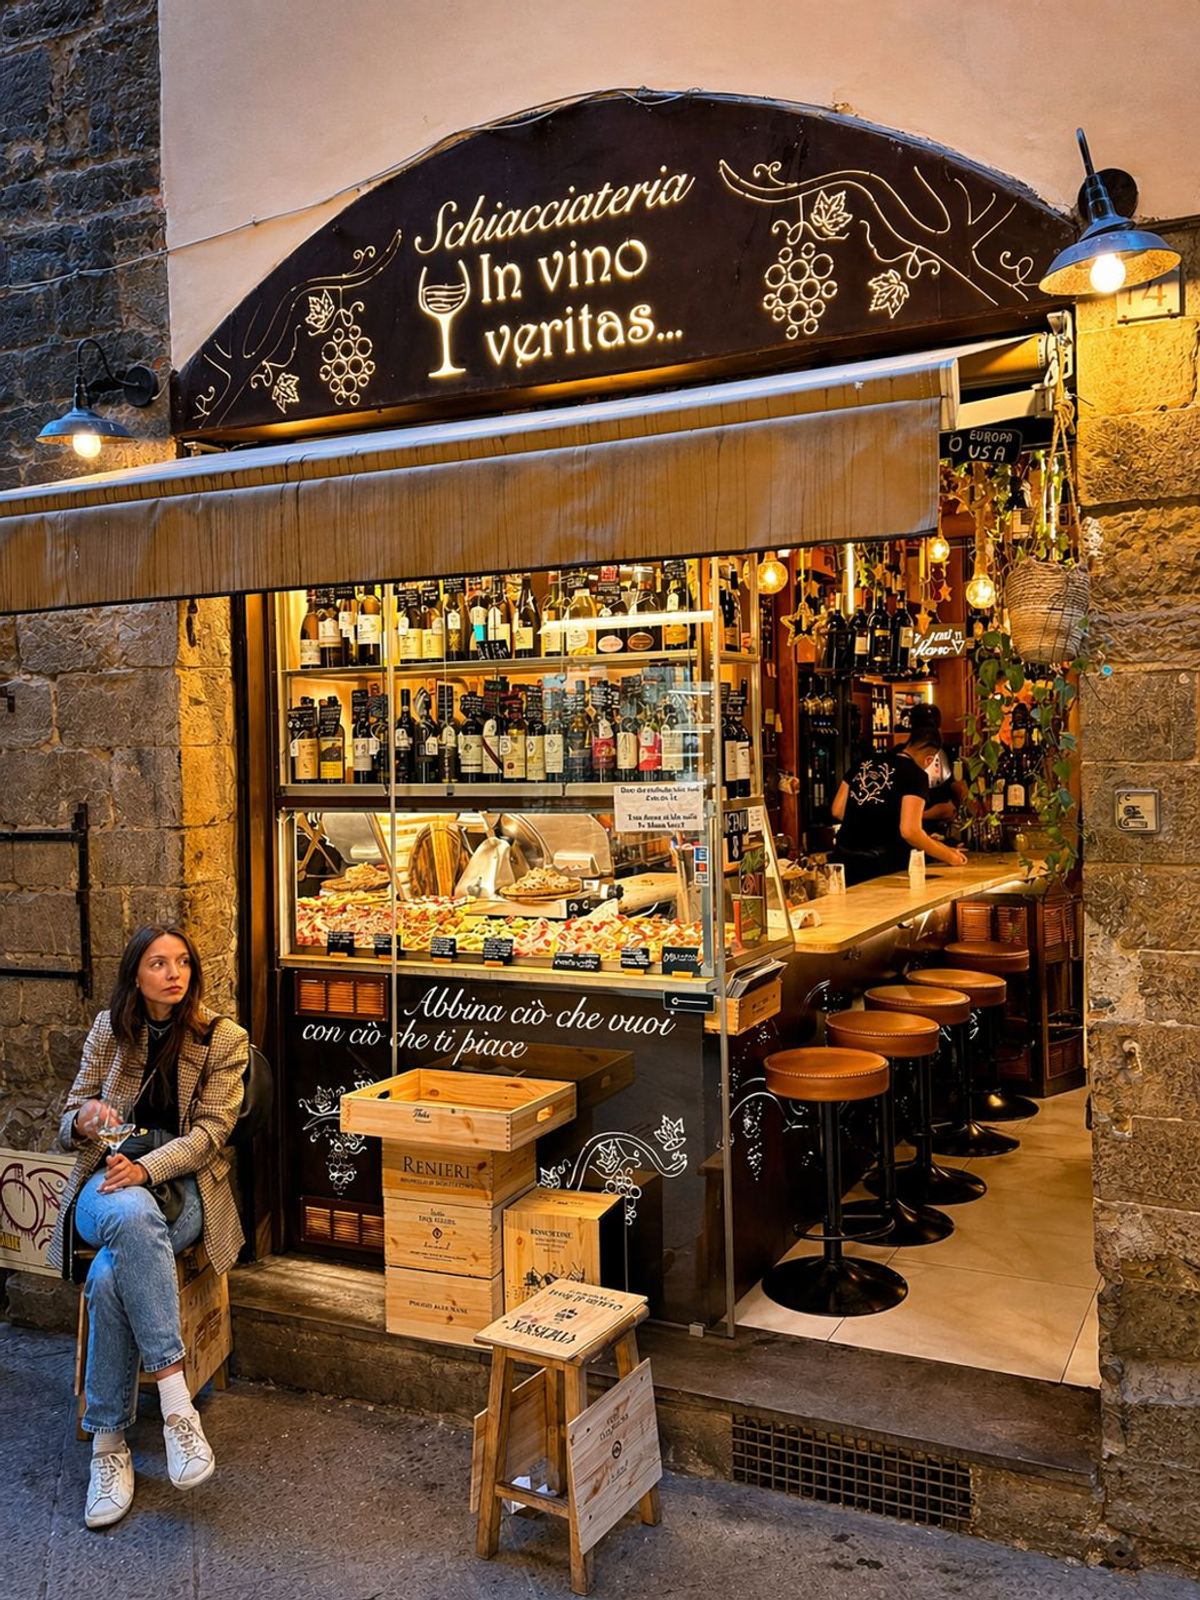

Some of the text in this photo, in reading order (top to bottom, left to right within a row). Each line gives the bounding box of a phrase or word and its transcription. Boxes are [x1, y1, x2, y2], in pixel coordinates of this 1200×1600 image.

[414, 164, 696, 254] Schiacciateria
[479, 239, 648, 304] In vino
[968, 444, 1006, 461] USA
[969, 429, 1013, 443] EUROPA
[403, 985, 677, 1036] Abbina ciò che vuoi
[302, 1018, 528, 1066] con ciò che ti piace
[403, 1155, 470, 1180] RENIERI
